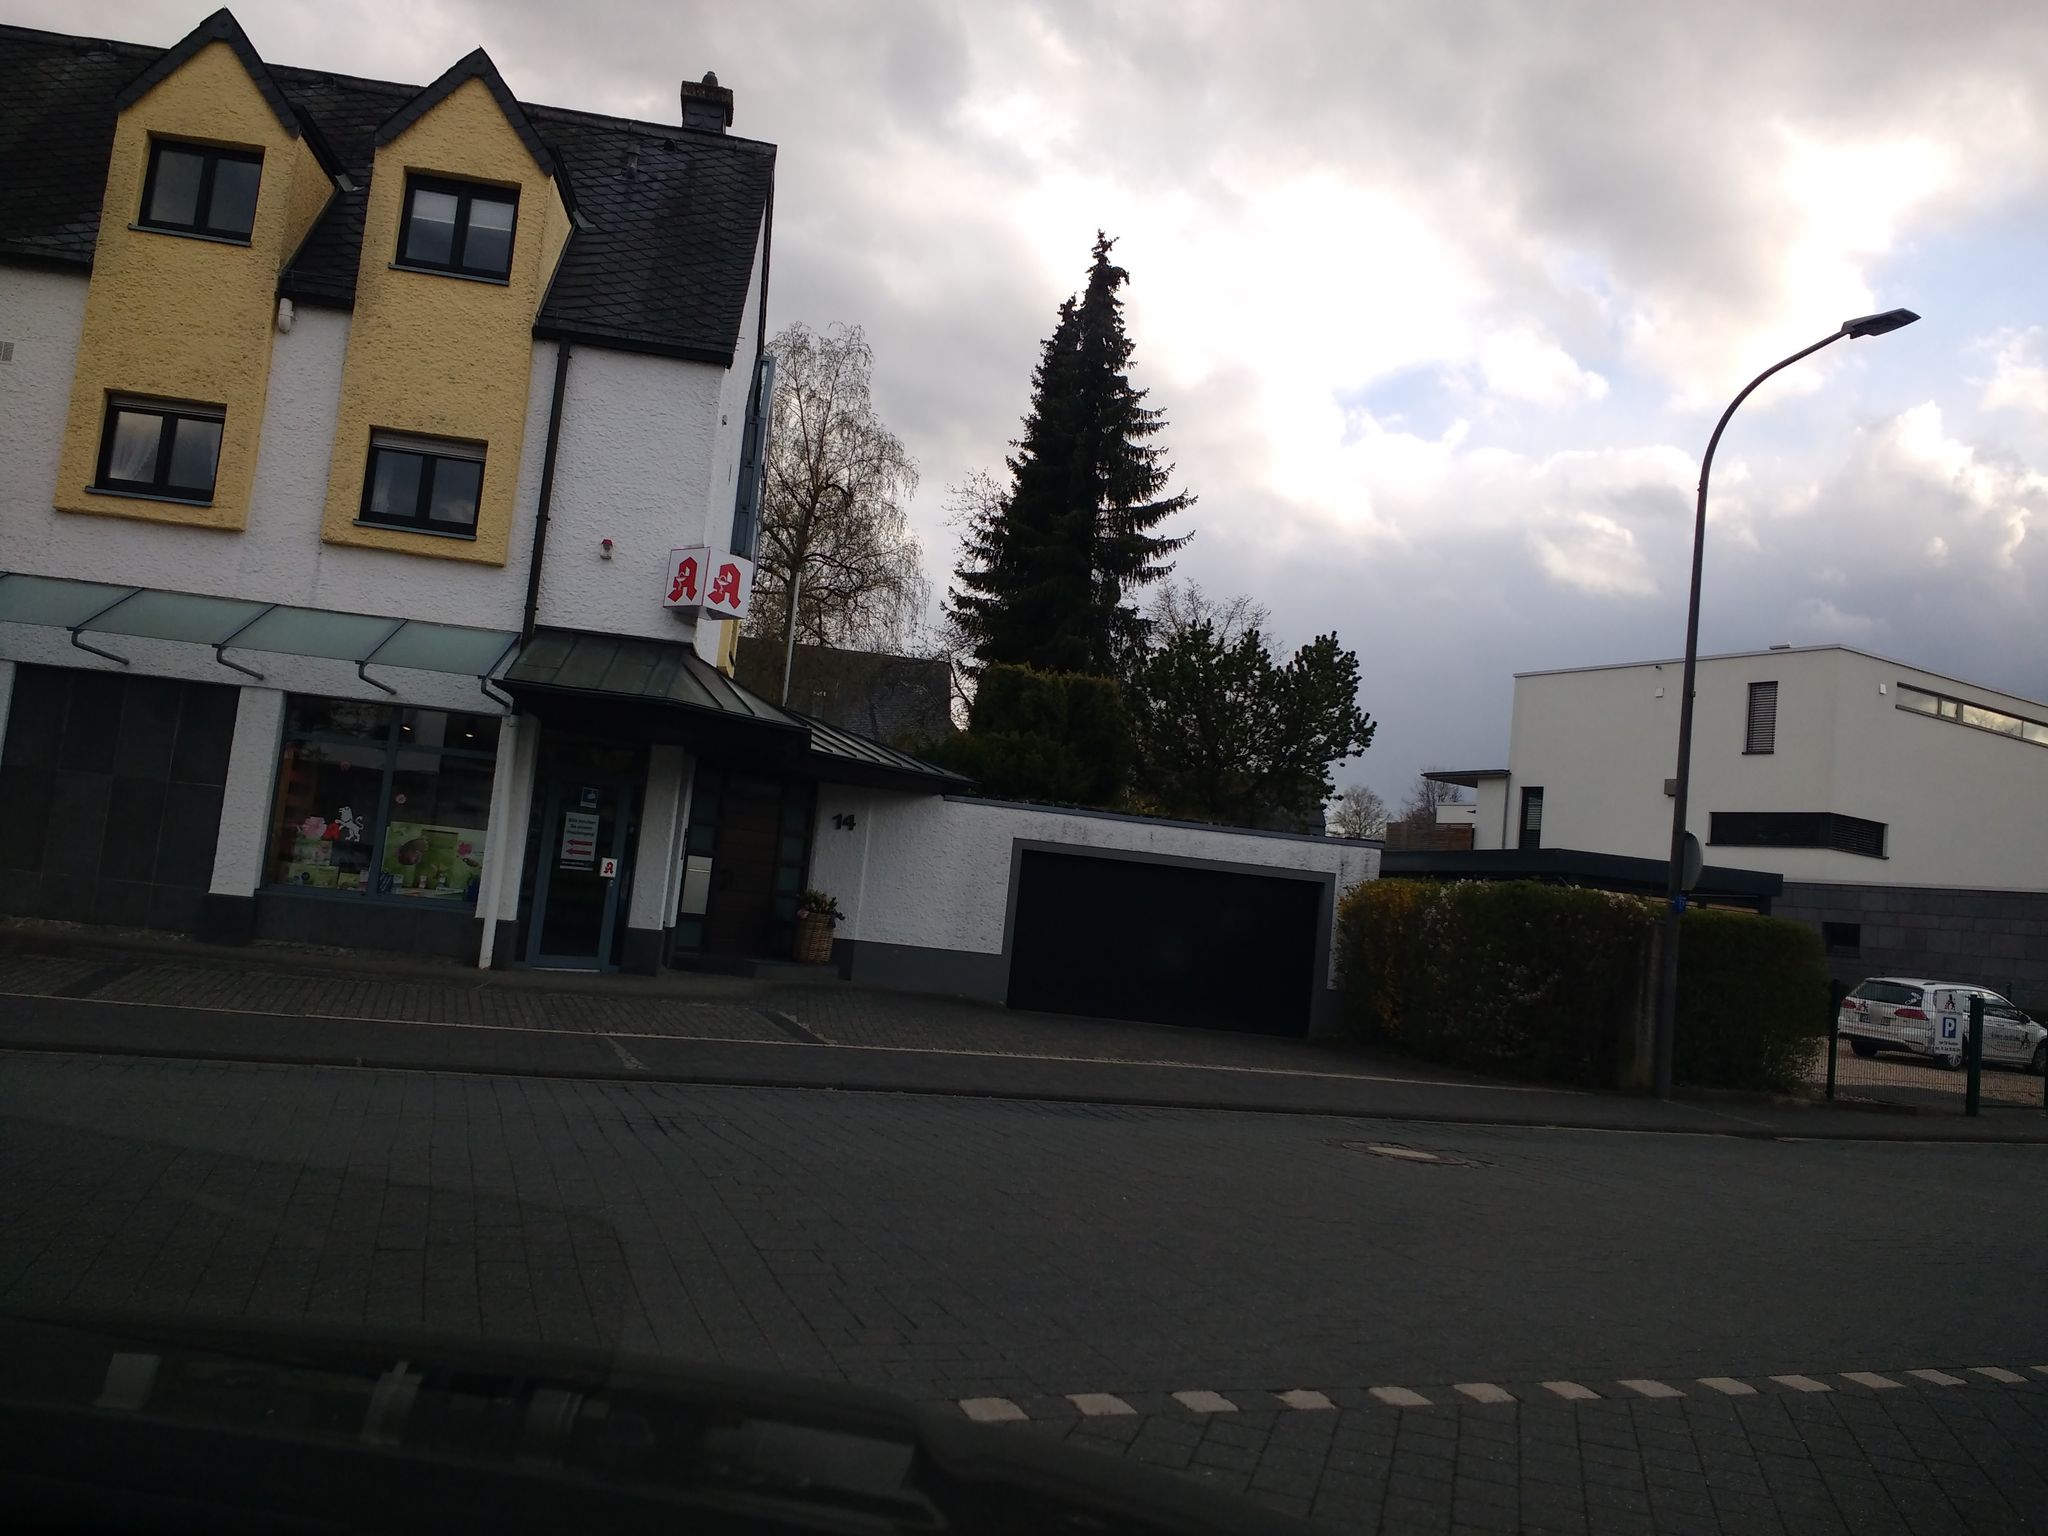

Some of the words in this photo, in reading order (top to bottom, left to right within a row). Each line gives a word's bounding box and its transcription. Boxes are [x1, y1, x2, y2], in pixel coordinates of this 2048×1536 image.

[667, 555, 698, 603] A
[707, 562, 742, 610] A
[832, 813, 857, 831] 14
[1944, 1018, 1955, 1037] P
